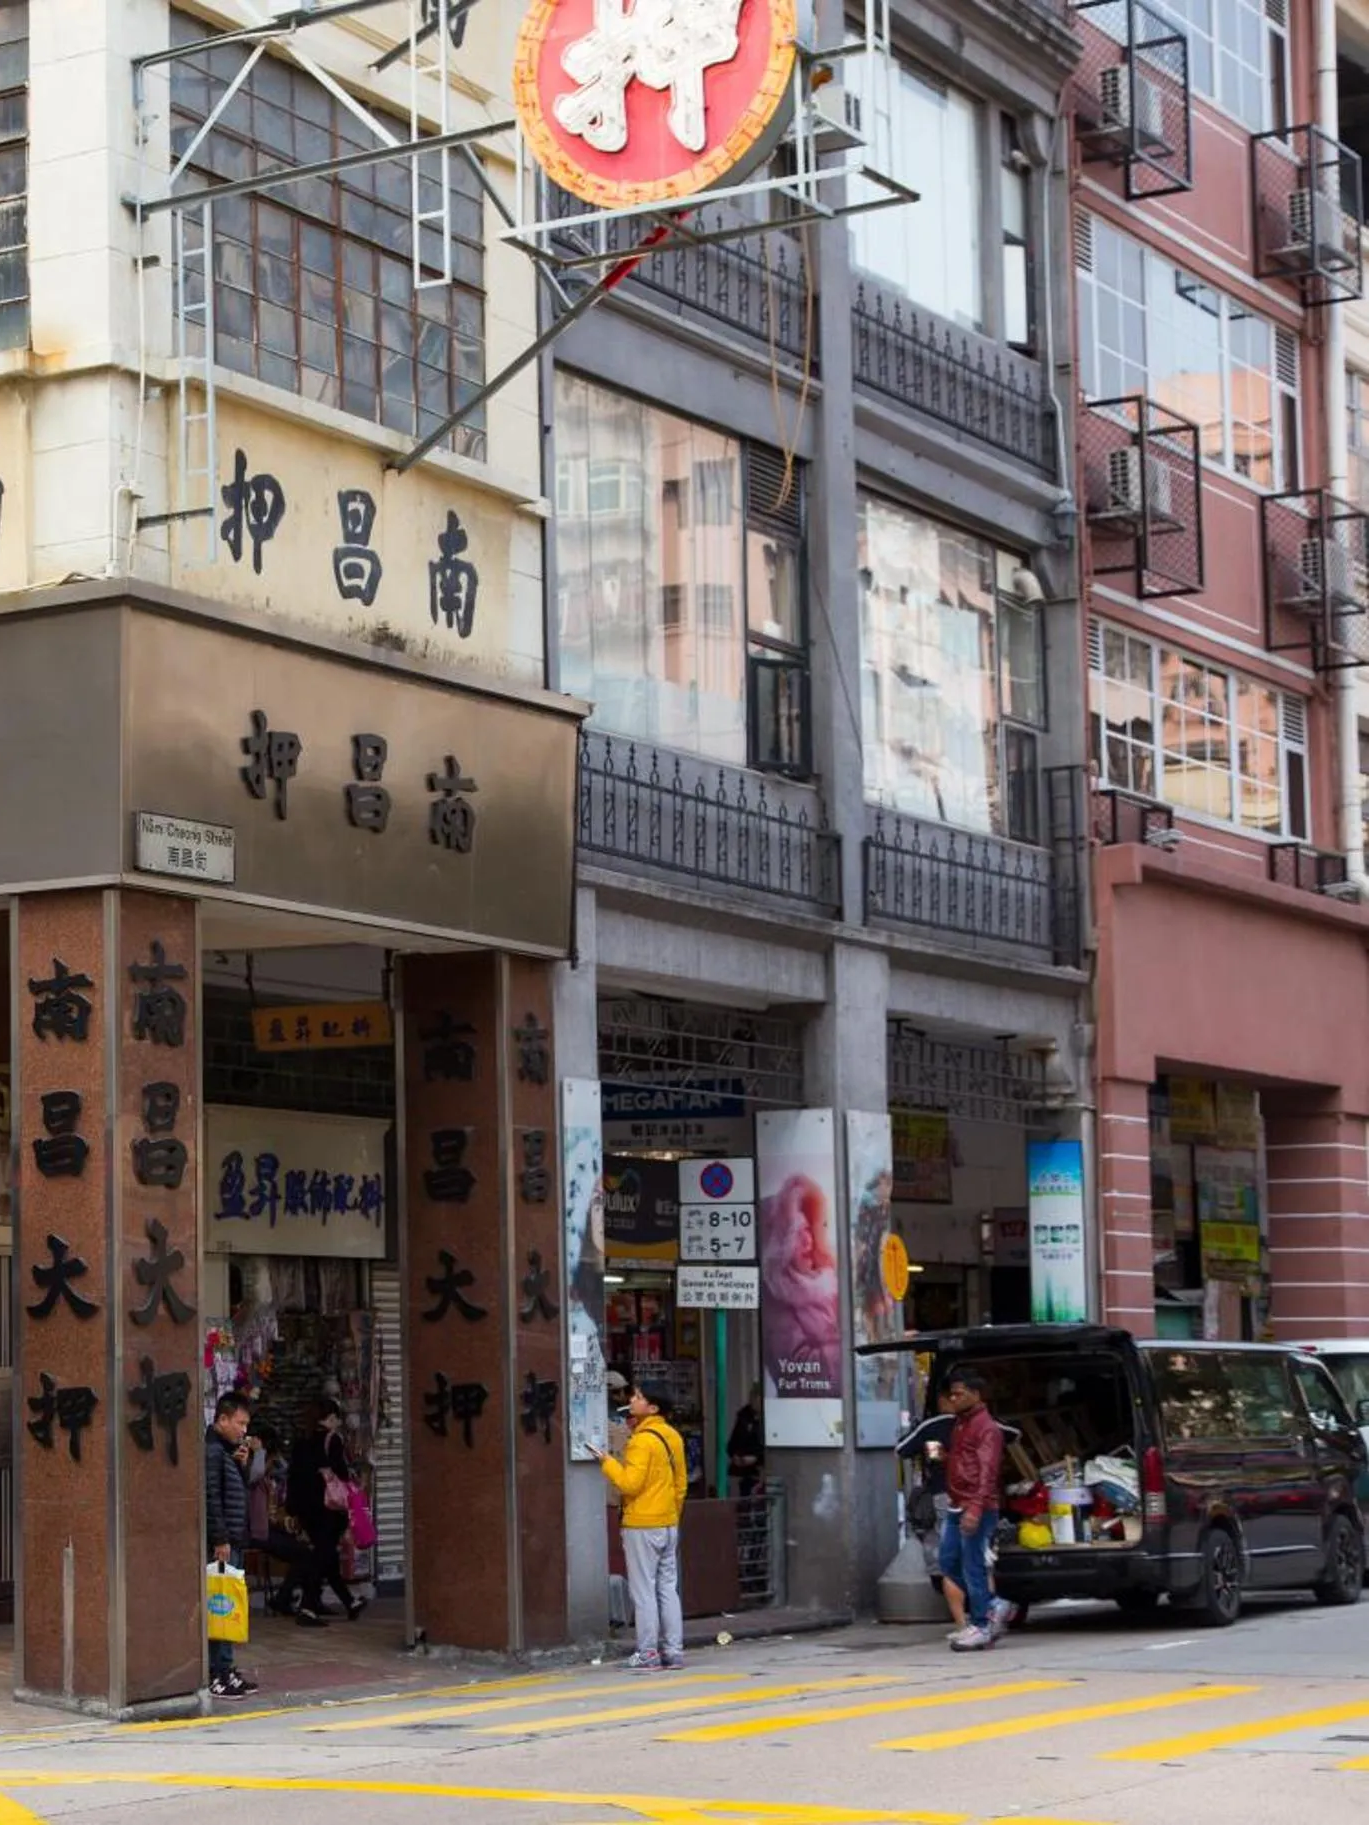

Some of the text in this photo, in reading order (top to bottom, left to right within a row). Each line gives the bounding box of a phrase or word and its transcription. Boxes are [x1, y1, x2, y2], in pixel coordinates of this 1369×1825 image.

[142, 818, 233, 847] Nam Cheong Street
[26, 956, 99, 1463] 南昌大押
[127, 940, 198, 1467] 南昌大押
[709, 1211, 751, 1227] 8-10
[710, 1237, 746, 1253] 5-7
[778, 1359, 821, 1373] Yovan
[778, 1377, 797, 1389] Fur
